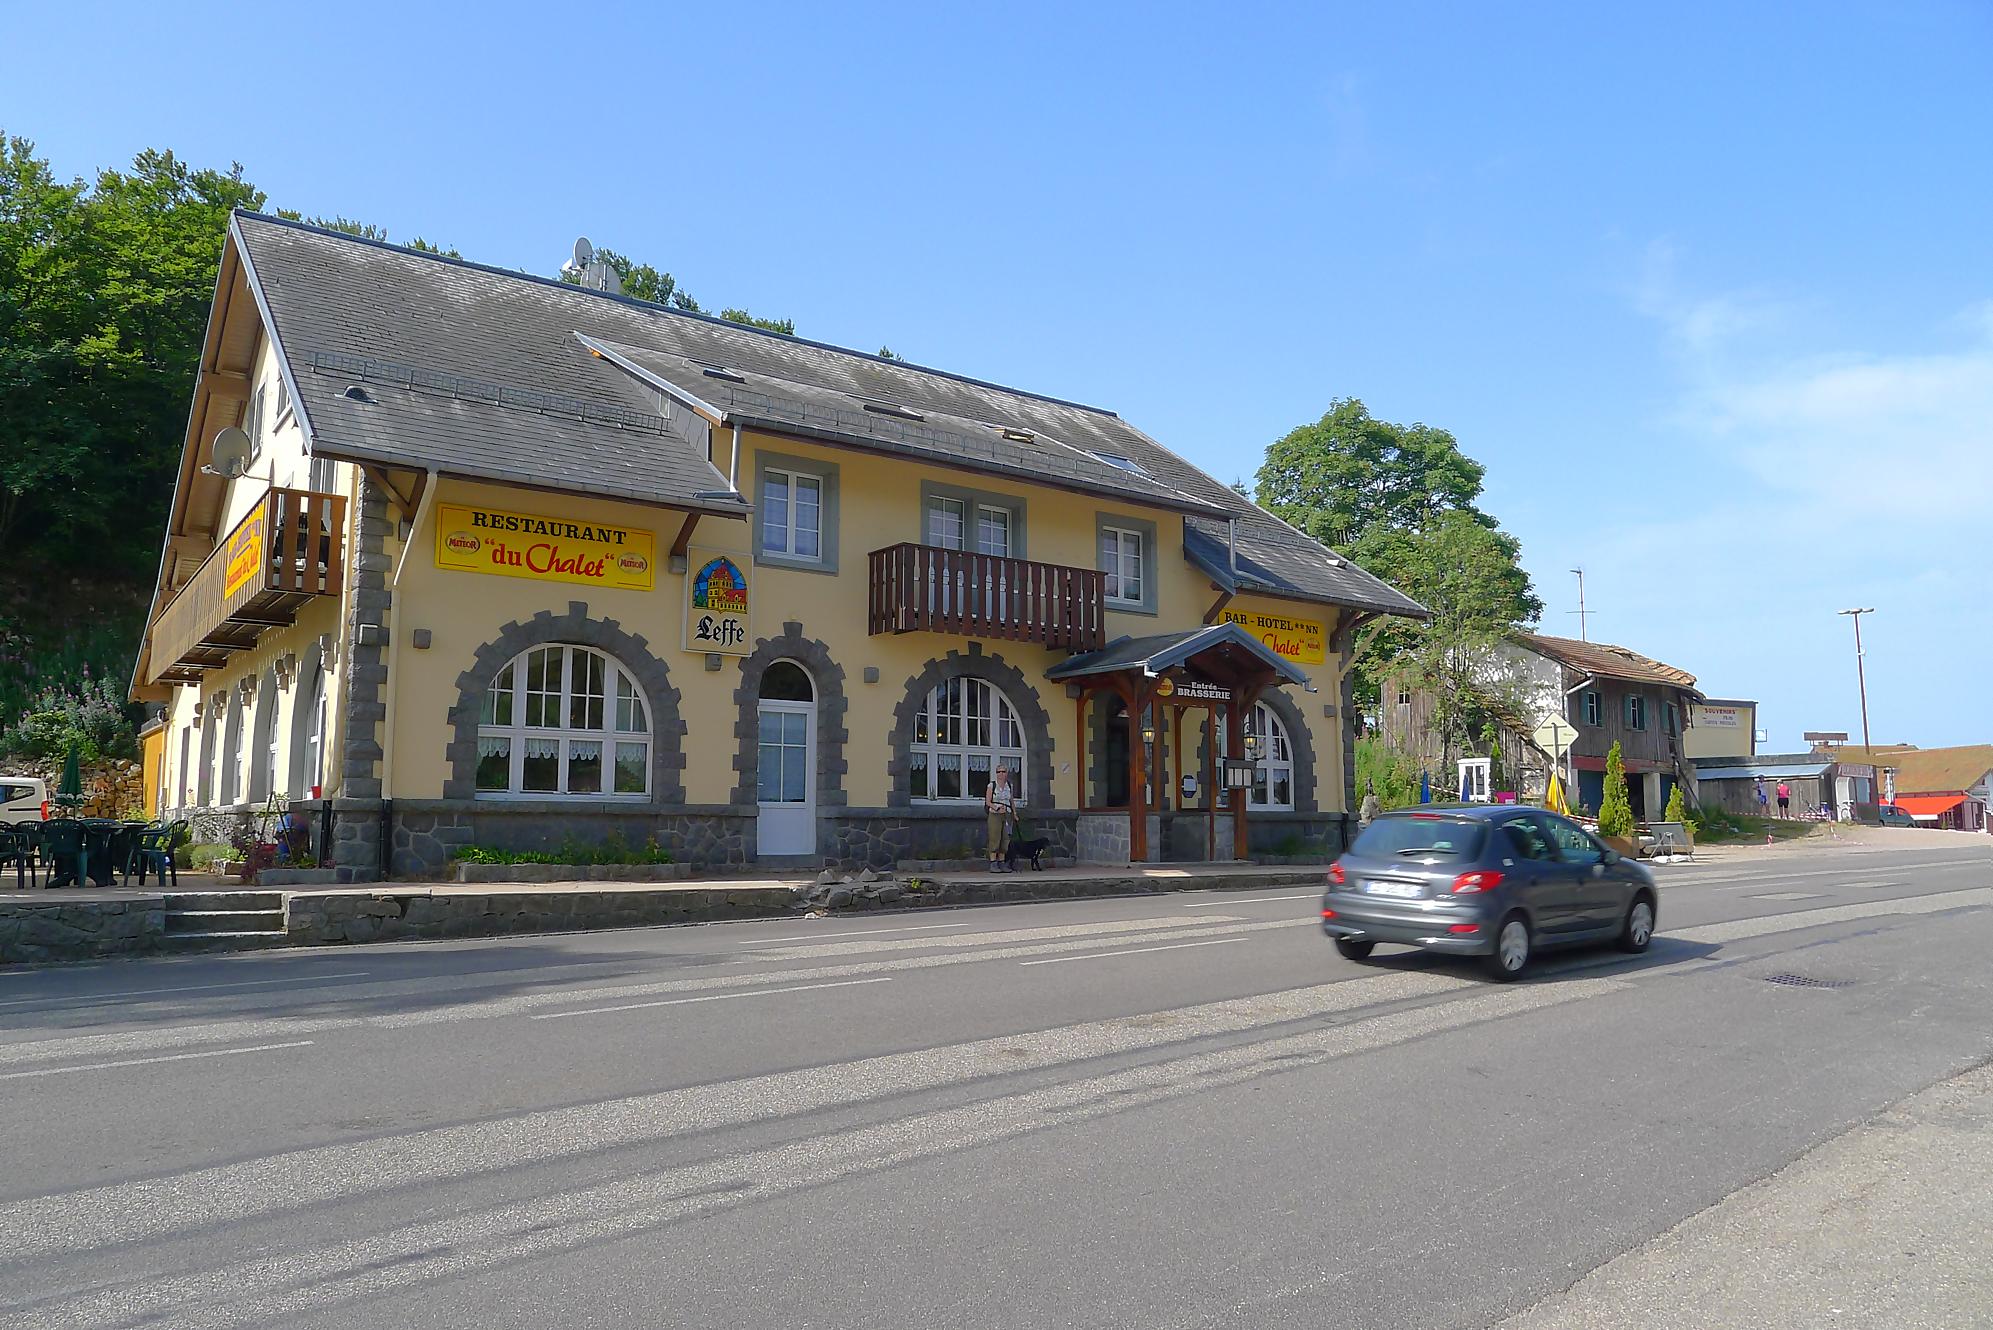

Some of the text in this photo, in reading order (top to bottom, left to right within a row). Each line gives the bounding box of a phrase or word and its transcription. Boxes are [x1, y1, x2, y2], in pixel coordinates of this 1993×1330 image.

[471, 511, 627, 545] RESTAURANT
[448, 536, 477, 550] METEOR
[1224, 611, 1248, 625] BAR
[1256, 616, 1294, 631] HOTEL
[694, 615, 745, 647] Leffe
[1177, 687, 1231, 700] BRASSERIE
[1191, 681, 1218, 691] Entrée
